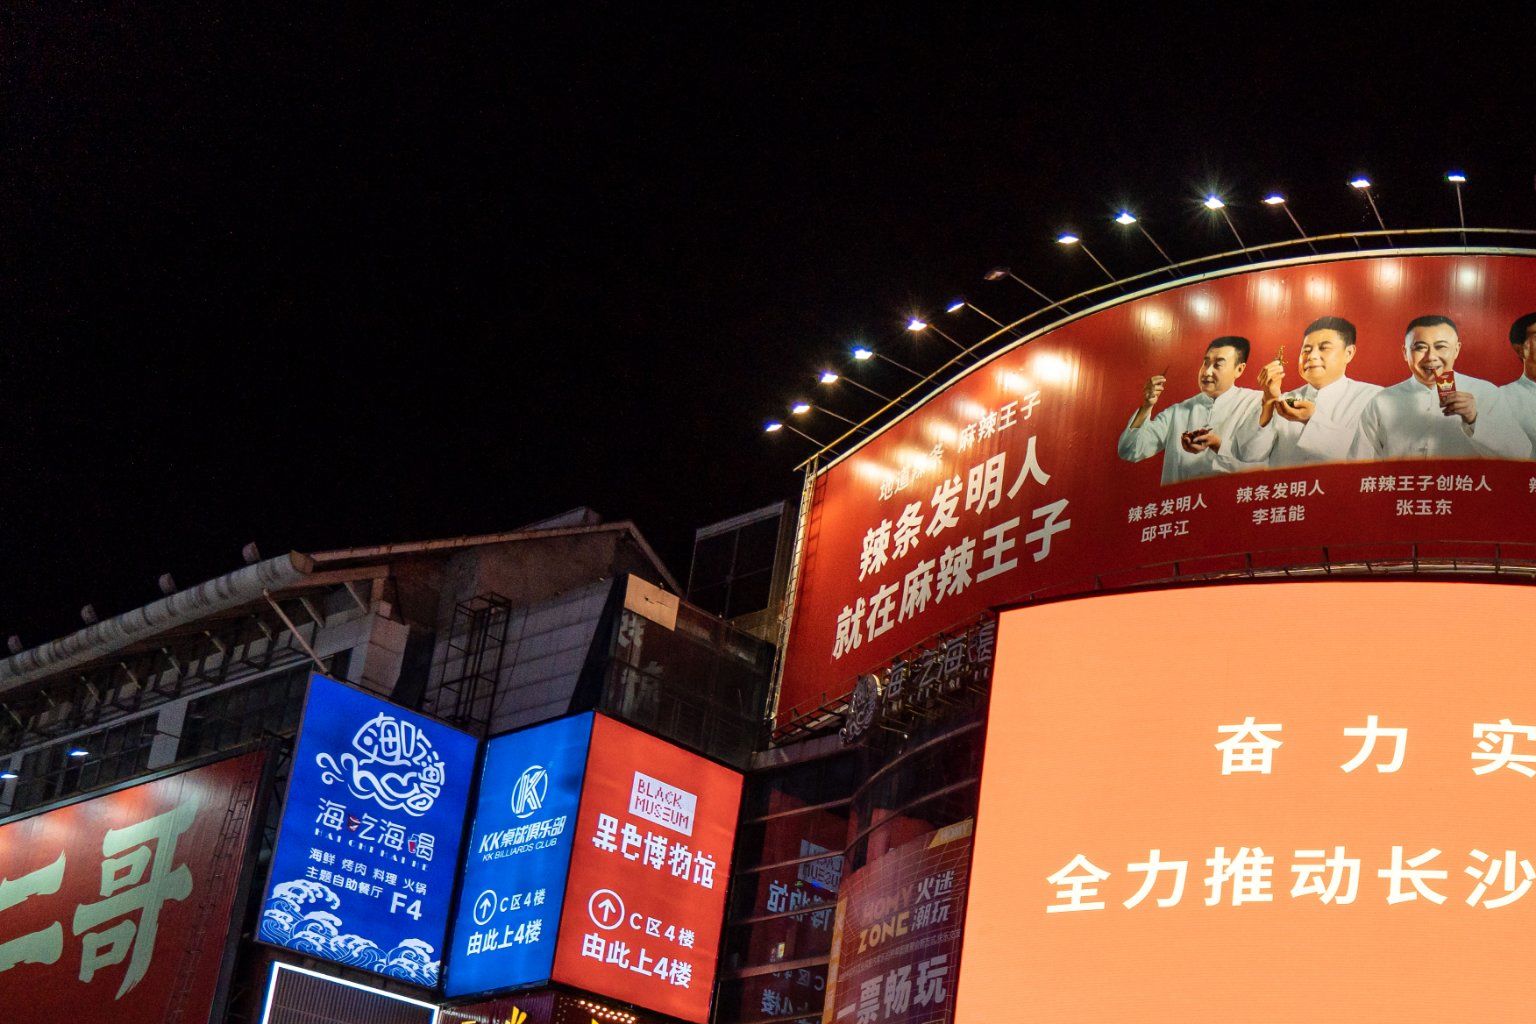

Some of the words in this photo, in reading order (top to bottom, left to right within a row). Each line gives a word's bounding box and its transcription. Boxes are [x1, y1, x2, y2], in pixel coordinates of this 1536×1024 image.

[1235, 478, 1325, 503] 辣条发明人
[1359, 475, 1493, 493] 麻辣王子创始人
[858, 435, 1051, 582] 辣条发明人
[1128, 491, 1208, 524] 辣条发明人
[1252, 504, 1306, 525] 李猛能
[1396, 498, 1453, 517] 张玉东
[1141, 520, 1189, 543] 邱平江
[831, 499, 1072, 661] 就在麻辣王子
[637, 778, 682, 810] BLACK
[634, 795, 690, 830] MUSEUM
[479, 815, 567, 853] KK桌球俱乐部
[495, 843, 534, 861] BILLIARDS
[535, 837, 558, 852] CLUB
[308, 847, 336, 867] 海鲜
[342, 857, 368, 877] 烤肉
[373, 867, 398, 887] 料理
[592, 812, 716, 890] 黑色博物馆
[305, 866, 384, 899] 主题自助餐厅
[916, 871, 955, 905] 火迷
[390, 891, 422, 921] F4
[499, 888, 546, 913] C区4楼
[911, 898, 952, 930] 潮玩
[467, 919, 542, 956] 由此上4楼
[629, 912, 695, 950] C区4楼
[857, 911, 910, 955] ZONE
[581, 932, 694, 989] 由此上4楼
